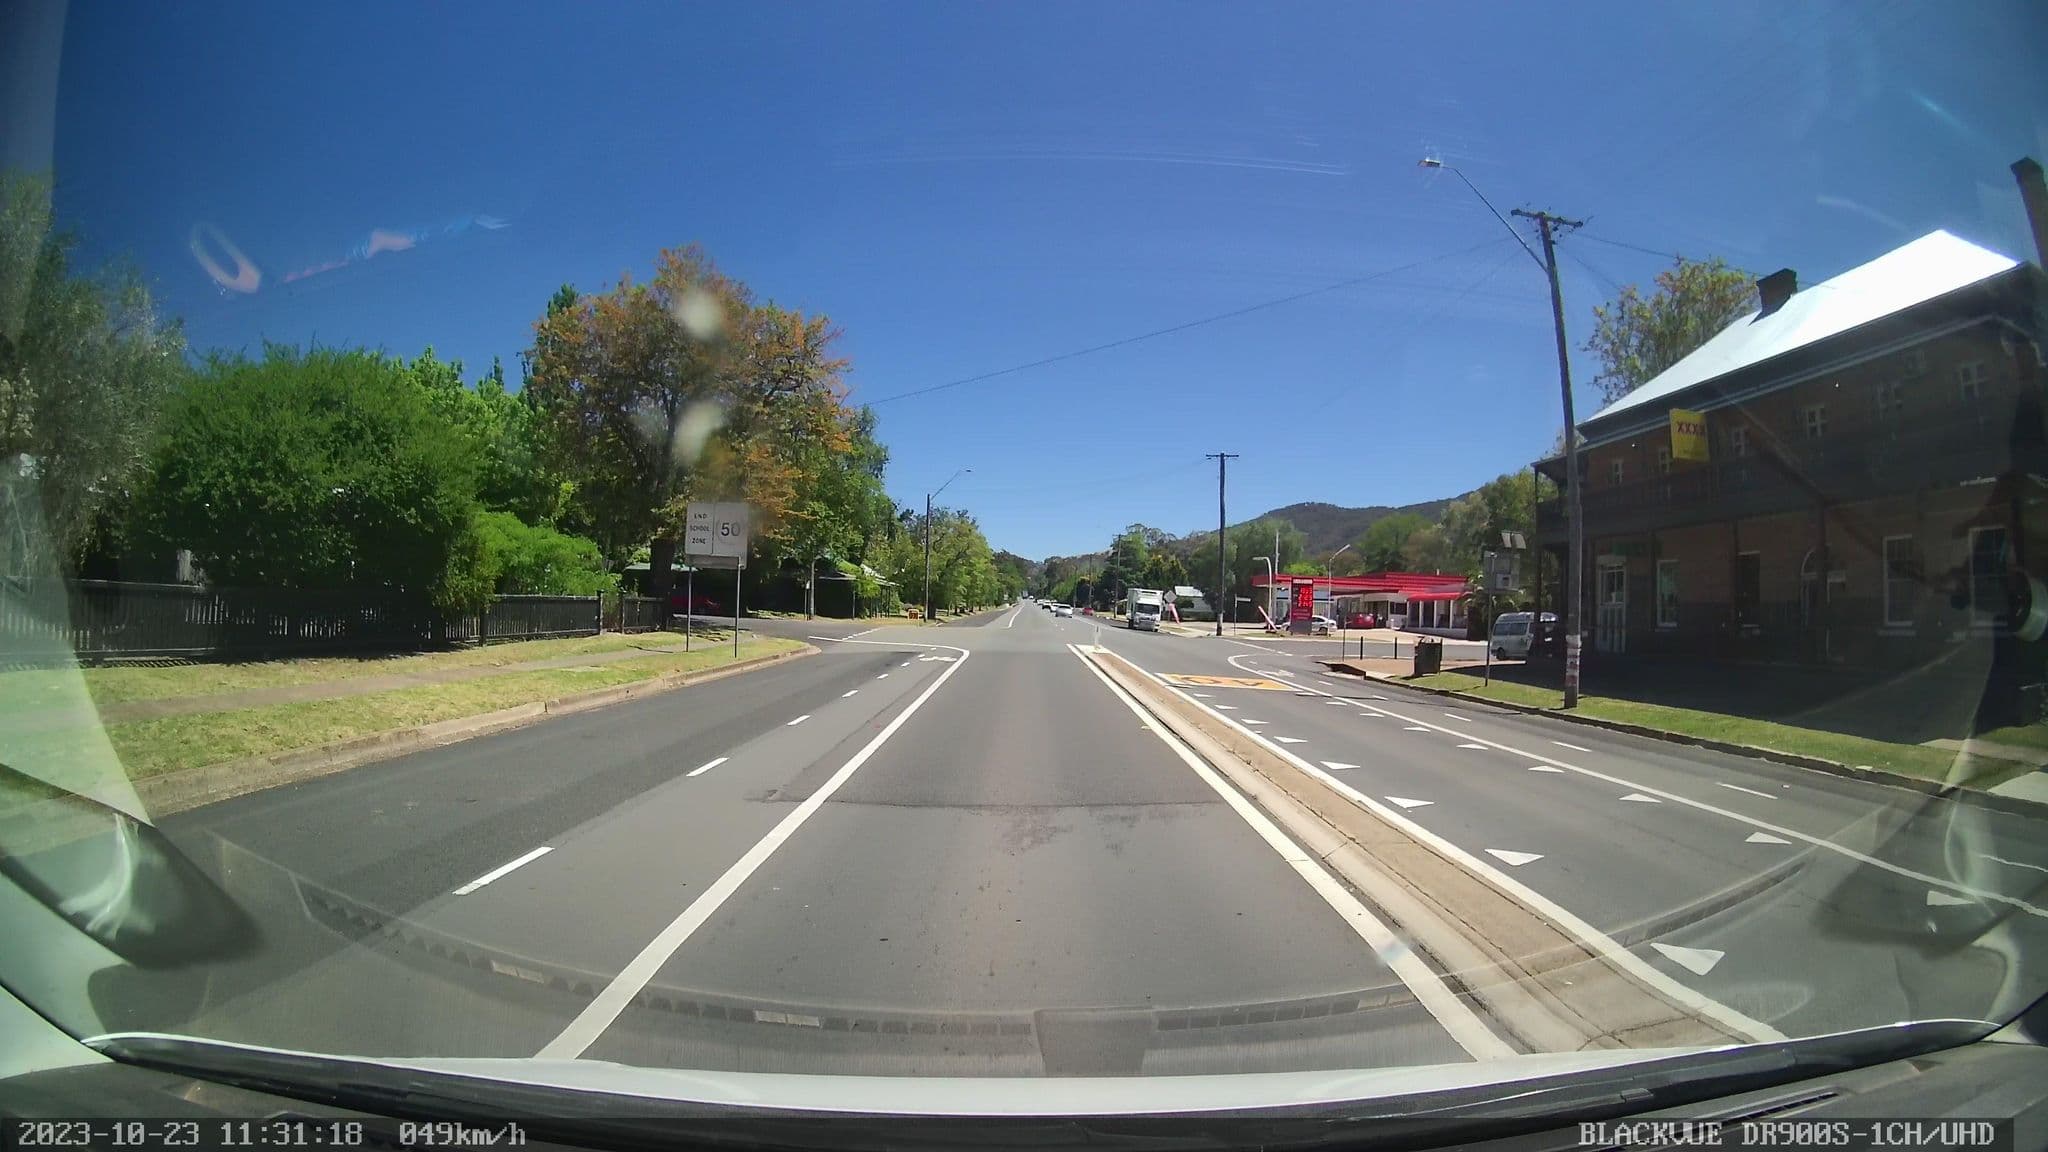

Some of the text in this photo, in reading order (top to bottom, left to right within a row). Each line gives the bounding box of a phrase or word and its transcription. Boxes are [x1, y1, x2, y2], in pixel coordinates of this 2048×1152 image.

[689, 524, 710, 532] SCHOOL
[720, 522, 741, 537] 50
[691, 537, 706, 545] ZONE
